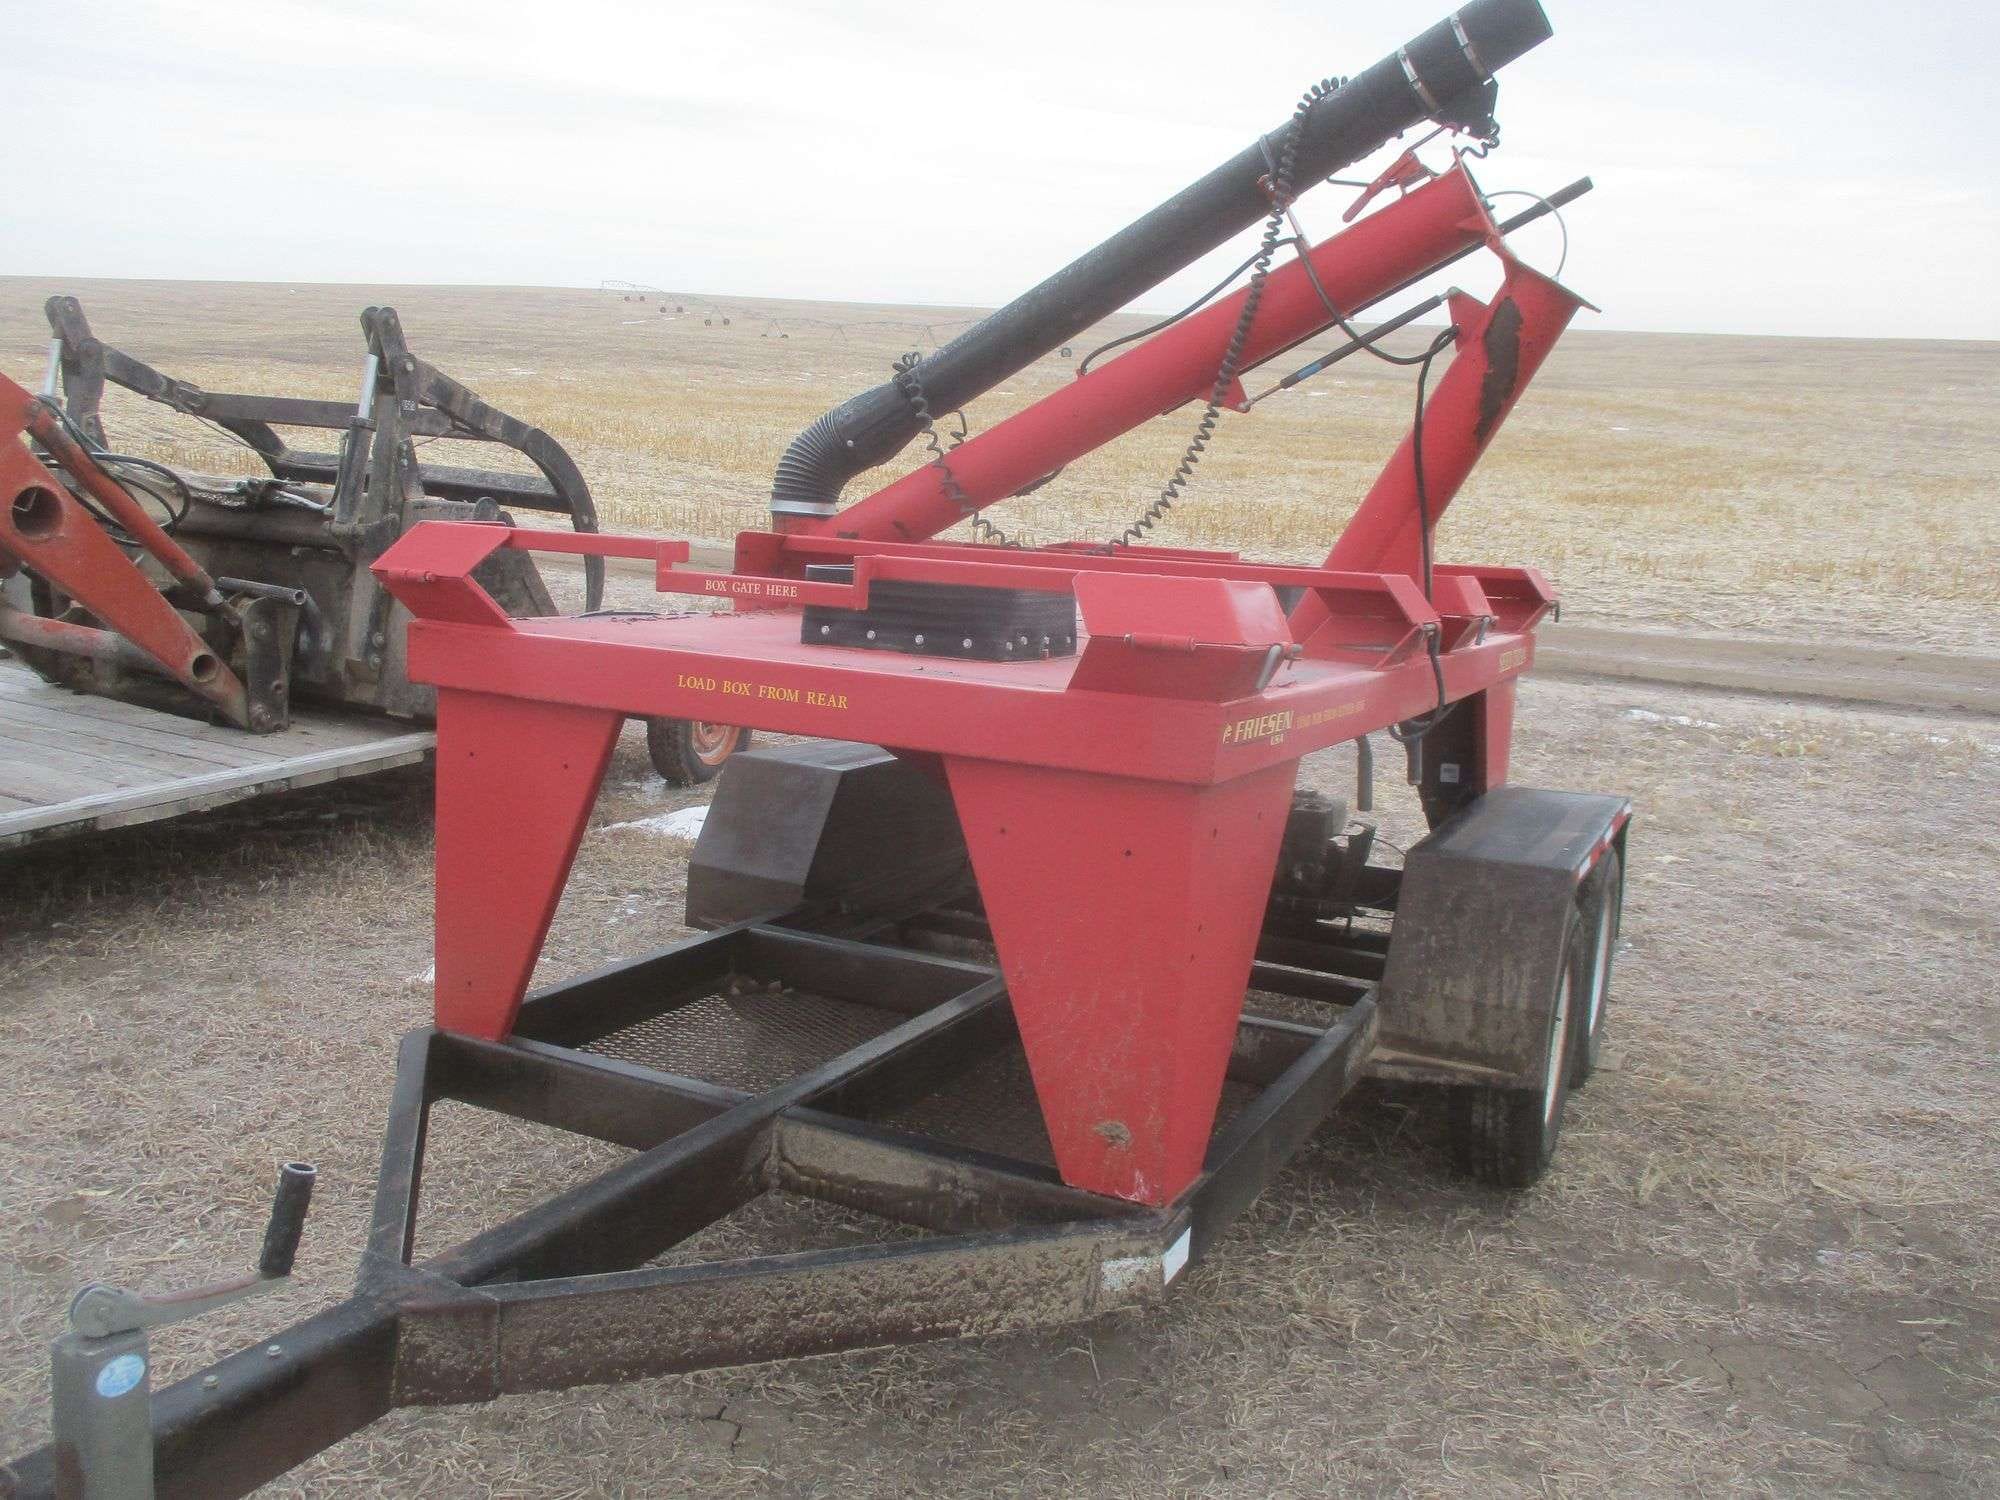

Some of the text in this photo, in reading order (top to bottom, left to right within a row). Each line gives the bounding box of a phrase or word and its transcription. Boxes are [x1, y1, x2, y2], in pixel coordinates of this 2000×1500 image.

[705, 579, 798, 598] BOX GATE HERE
[678, 674, 848, 709] LOAD BOX FROM REAR
[1234, 710, 1295, 743] FRIESEN
